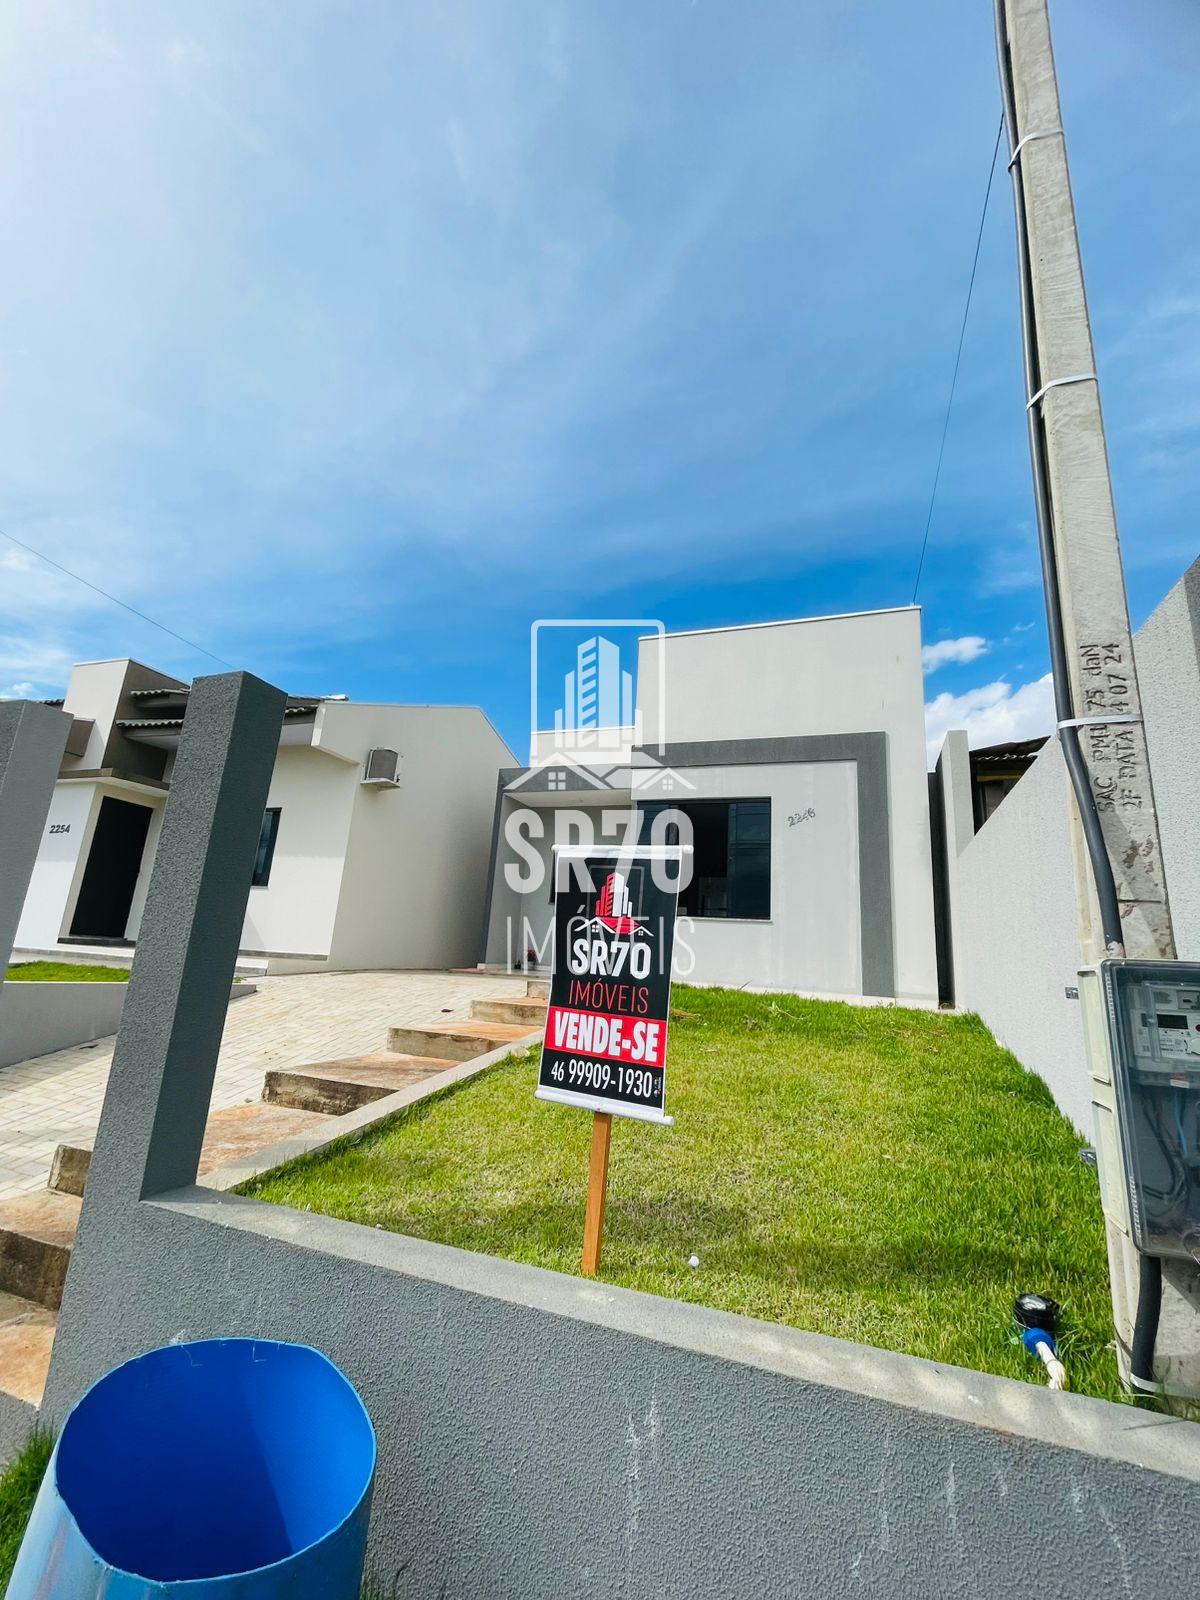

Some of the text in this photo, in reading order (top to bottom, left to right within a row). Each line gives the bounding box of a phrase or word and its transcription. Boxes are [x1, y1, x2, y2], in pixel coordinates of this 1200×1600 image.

[1102, 643, 1122, 665] 24
[1085, 690, 1106, 711] 75
[1107, 674, 1128, 695] 07
[1115, 730, 1137, 779] DATA
[49, 824, 71, 834] 2254
[571, 938, 652, 980] SR70
[568, 977, 650, 1014] IMÓVEIS
[554, 1010, 660, 1063] VENDE-SE
[551, 1060, 565, 1082] 46
[568, 1058, 653, 1098] 99909-1930
